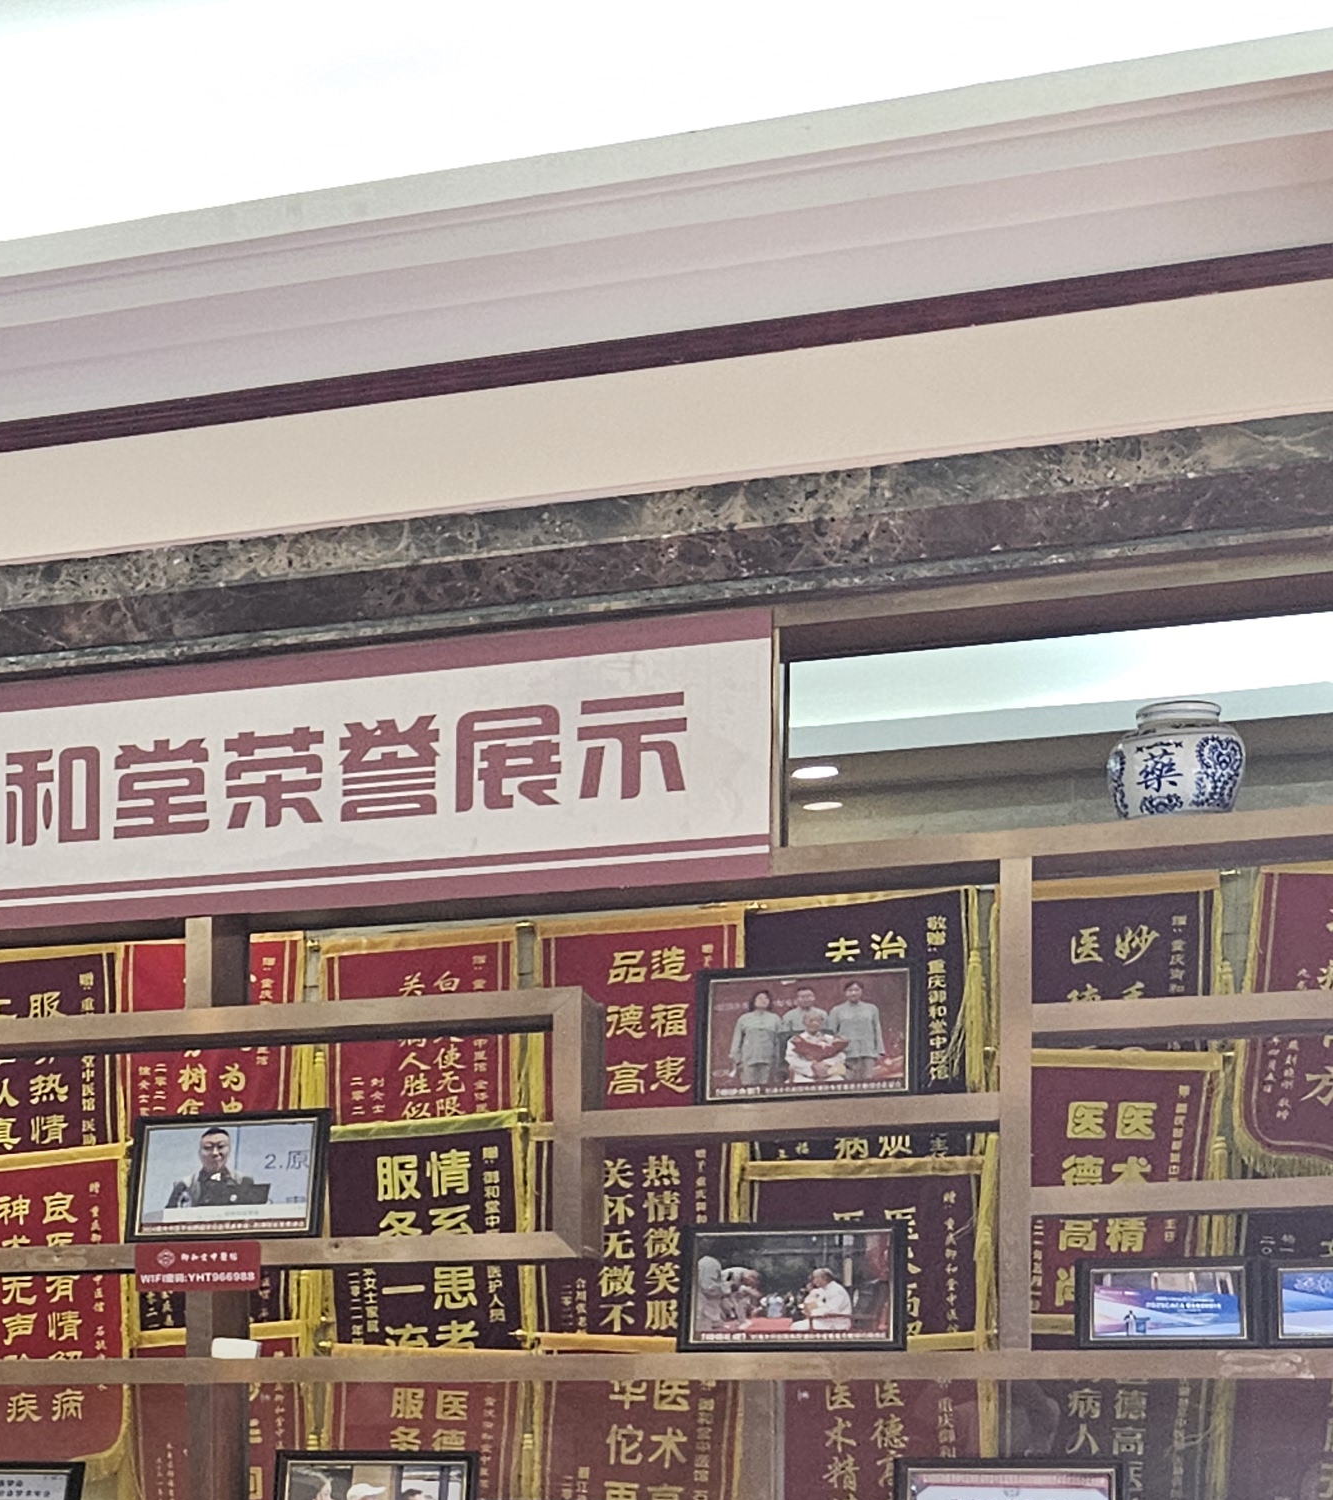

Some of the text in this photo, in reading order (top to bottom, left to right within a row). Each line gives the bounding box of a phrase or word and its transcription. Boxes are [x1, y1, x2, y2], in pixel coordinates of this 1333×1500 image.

[28, 991, 69, 1145] 服热情
[433, 970, 467, 1115] 白使无限
[606, 950, 648, 1095] 品德高
[650, 946, 692, 1095] 造福患
[41, 1191, 86, 1422] 良有情病
[598, 1158, 636, 1332] 关怀无微不
[642, 1155, 681, 1331] 热情微笑服
